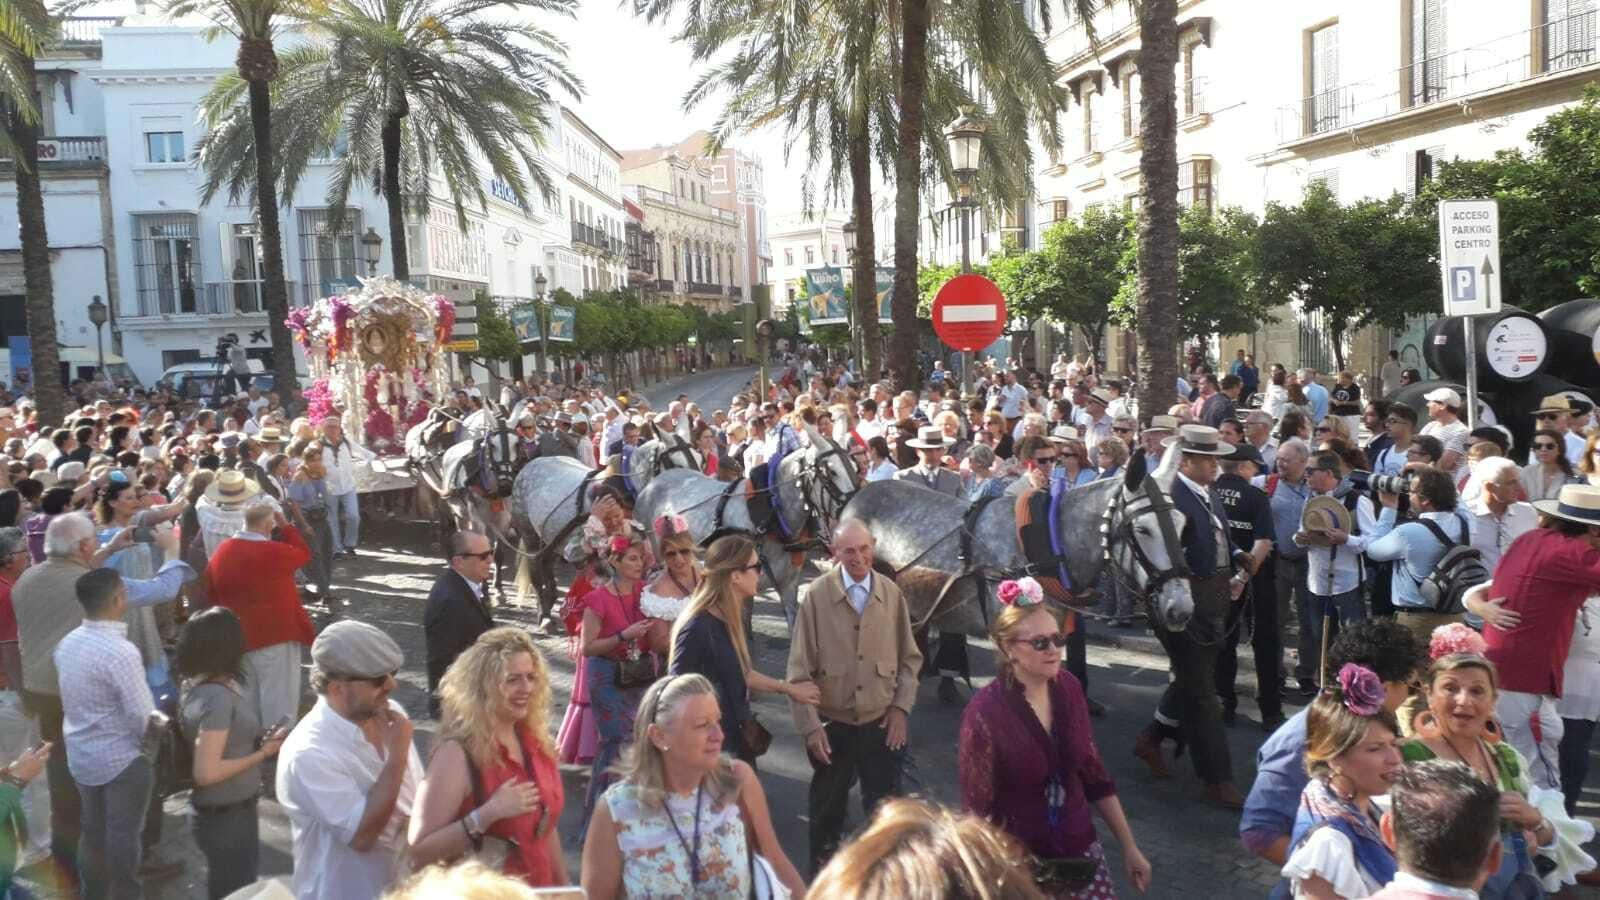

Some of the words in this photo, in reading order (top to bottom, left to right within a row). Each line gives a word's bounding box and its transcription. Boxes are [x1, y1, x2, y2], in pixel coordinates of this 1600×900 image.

[1453, 211, 1489, 221] ACCESO
[1451, 225, 1492, 235] PARKING
[1454, 240, 1490, 250] CENTRO
[1456, 270, 1472, 298] P
